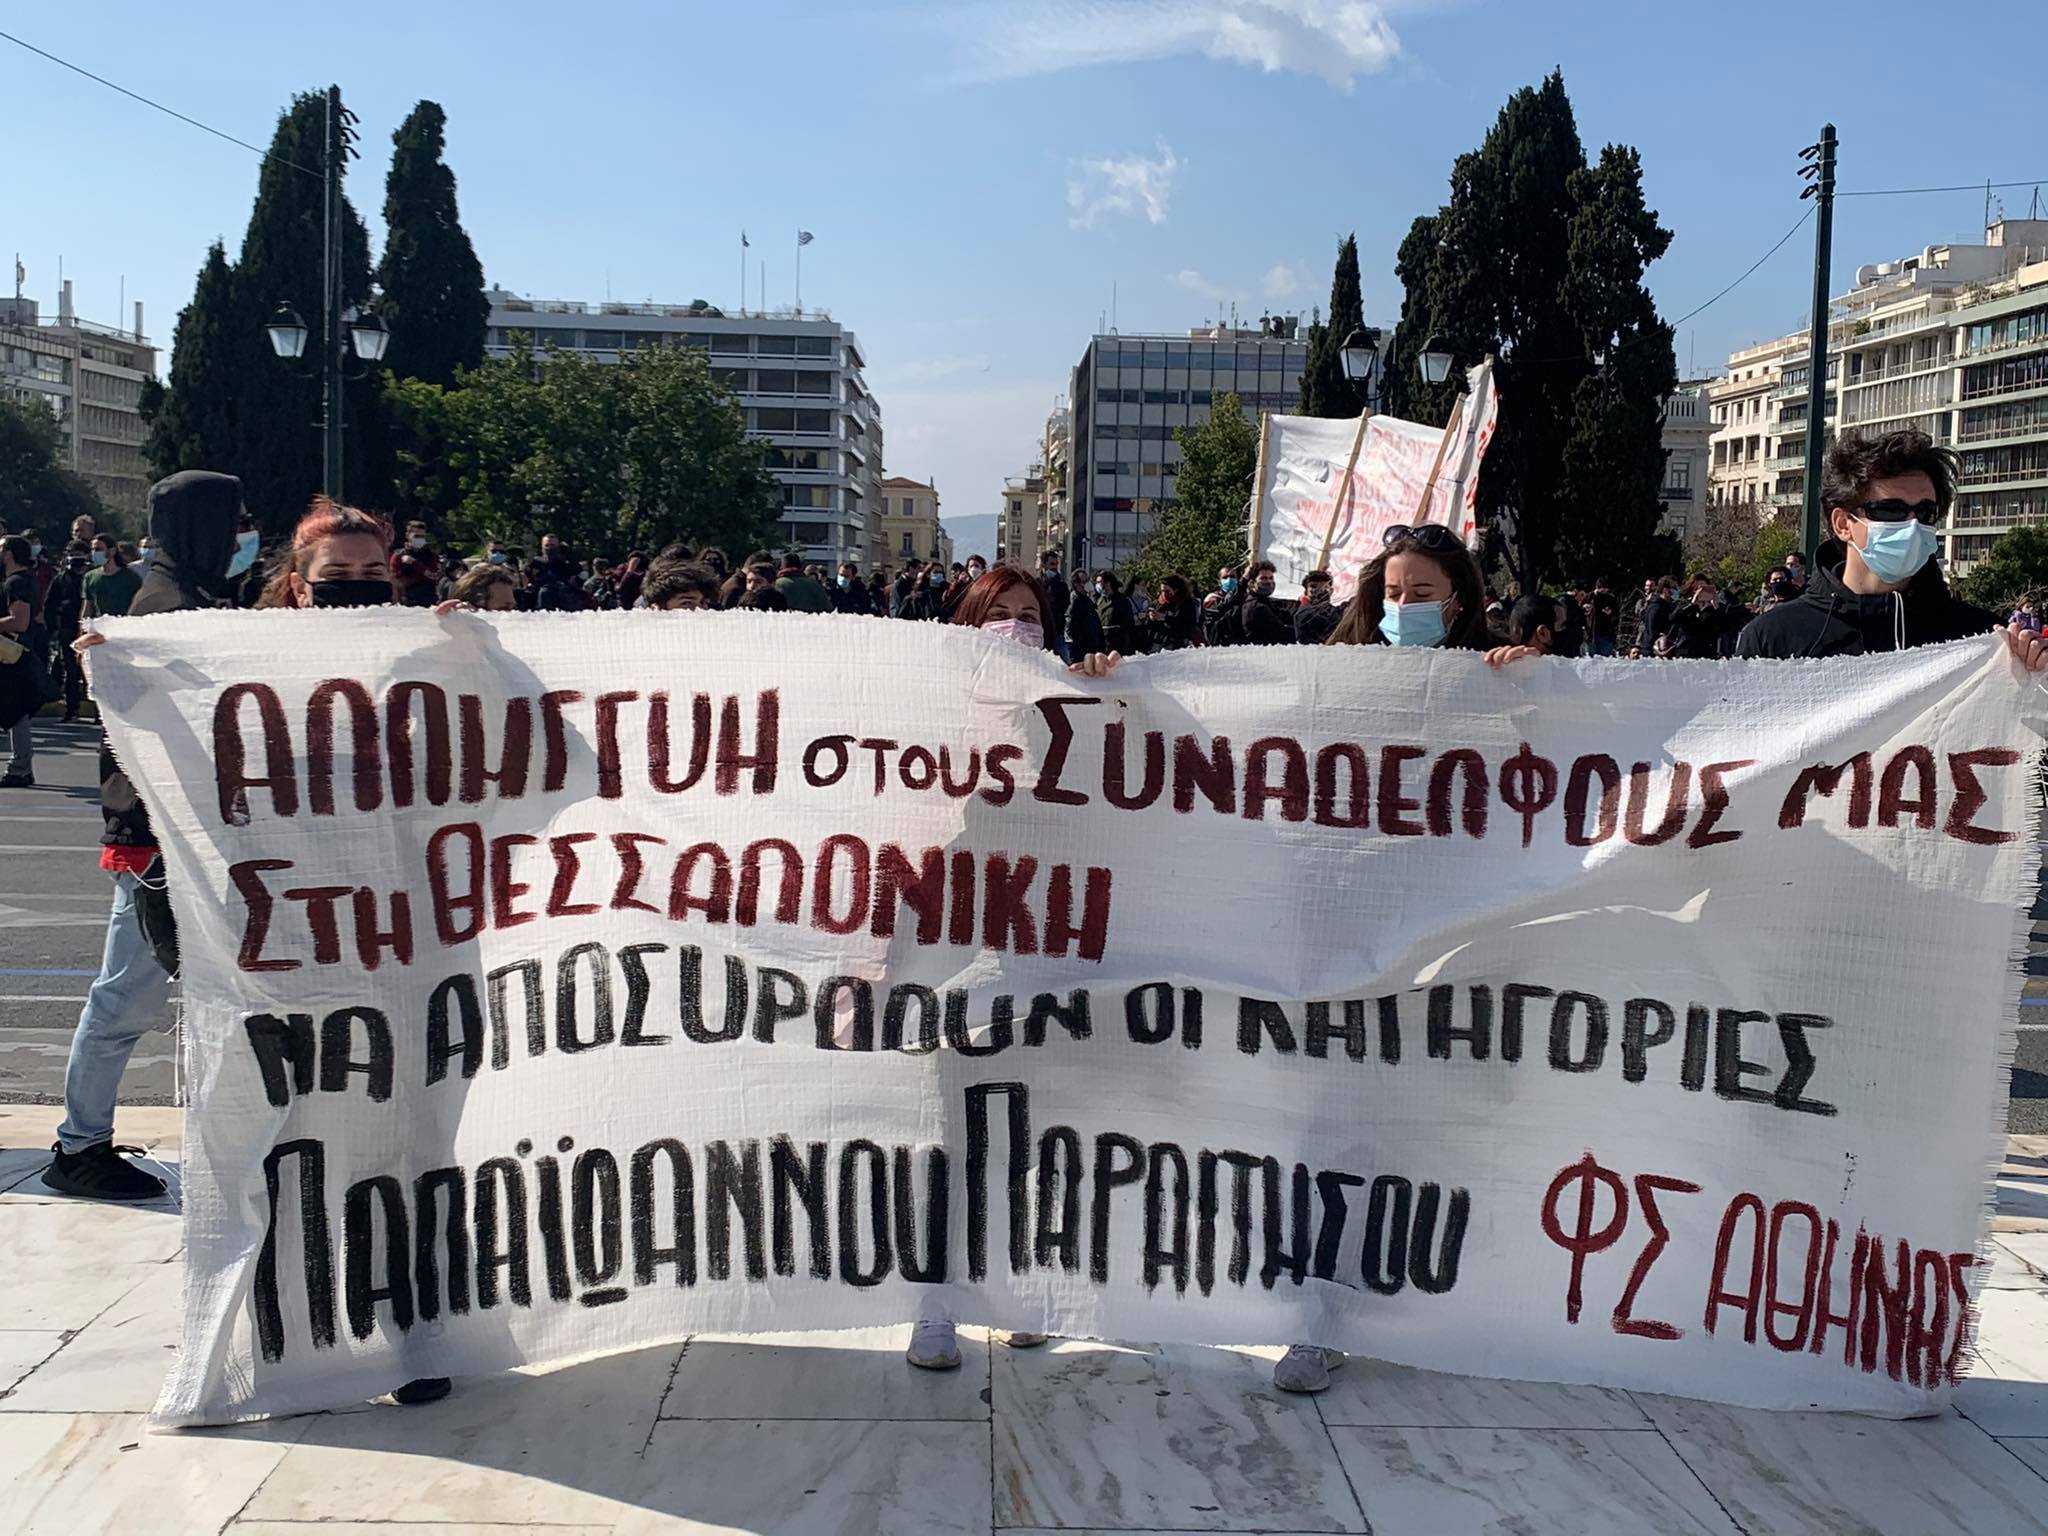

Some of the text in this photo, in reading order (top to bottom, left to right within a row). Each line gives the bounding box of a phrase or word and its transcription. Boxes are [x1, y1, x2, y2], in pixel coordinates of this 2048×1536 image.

[1033, 696, 1759, 849] ΣΥΝΑΔΕΛΦΟΥΣ
[1778, 744, 2021, 846] ΜΑΣ
[228, 822, 1112, 971] ΣΤΗ ΘΕΣΣΑΛΟΝΙΚΗ
[244, 1005, 395, 1107] ΝΑ
[1123, 982, 1202, 1050] ΟΙ
[964, 1080, 1470, 1298] ΠΑΡΑΙΤΗΣΟΥ
[1541, 1147, 1988, 1392] ΦΣ ΑΘΗΝΑΣ
